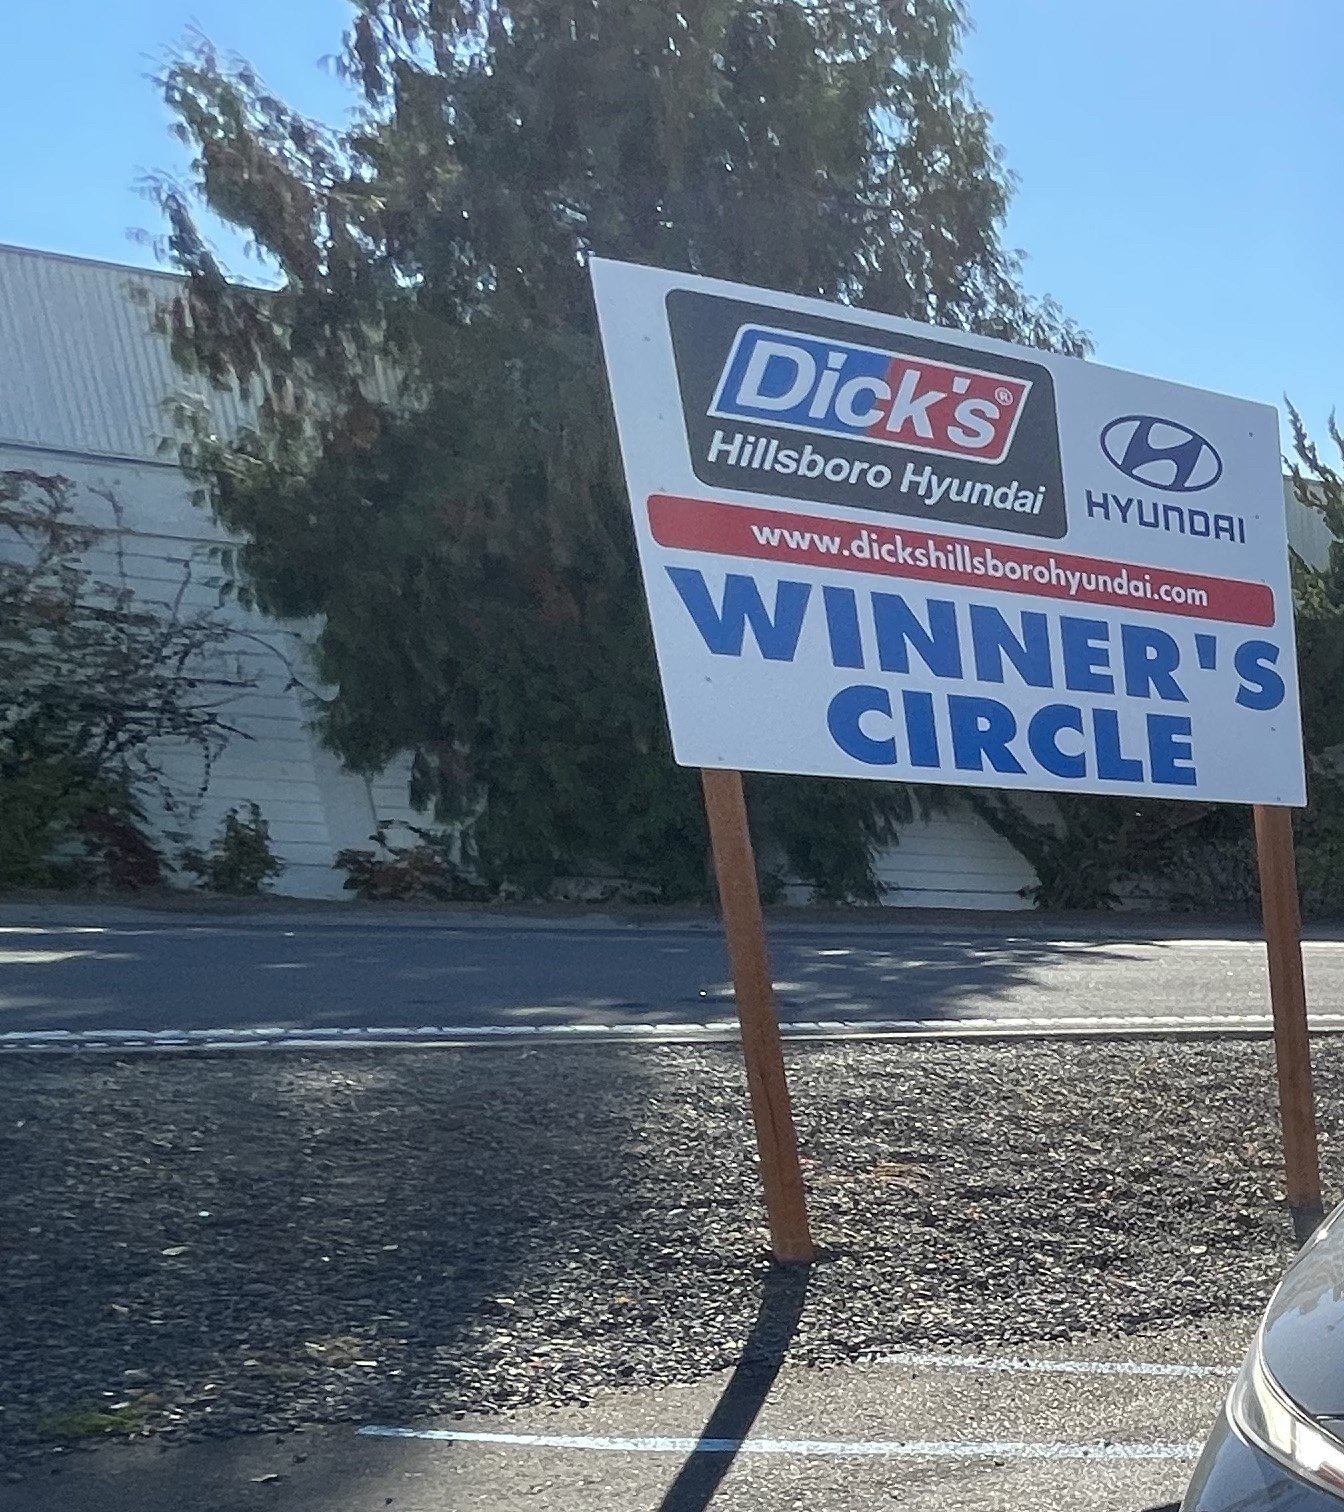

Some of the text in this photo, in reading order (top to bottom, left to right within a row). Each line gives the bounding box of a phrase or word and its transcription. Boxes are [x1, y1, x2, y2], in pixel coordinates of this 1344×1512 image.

[707, 430, 1046, 515] Hillsboro Hyundai
[1086, 490, 1247, 544] HYUNDAI
[751, 521, 1209, 608] www.dickshillsborohyundai.com
[665, 565, 1286, 711] WINNER'S
[827, 684, 1198, 787] CIRCLE
